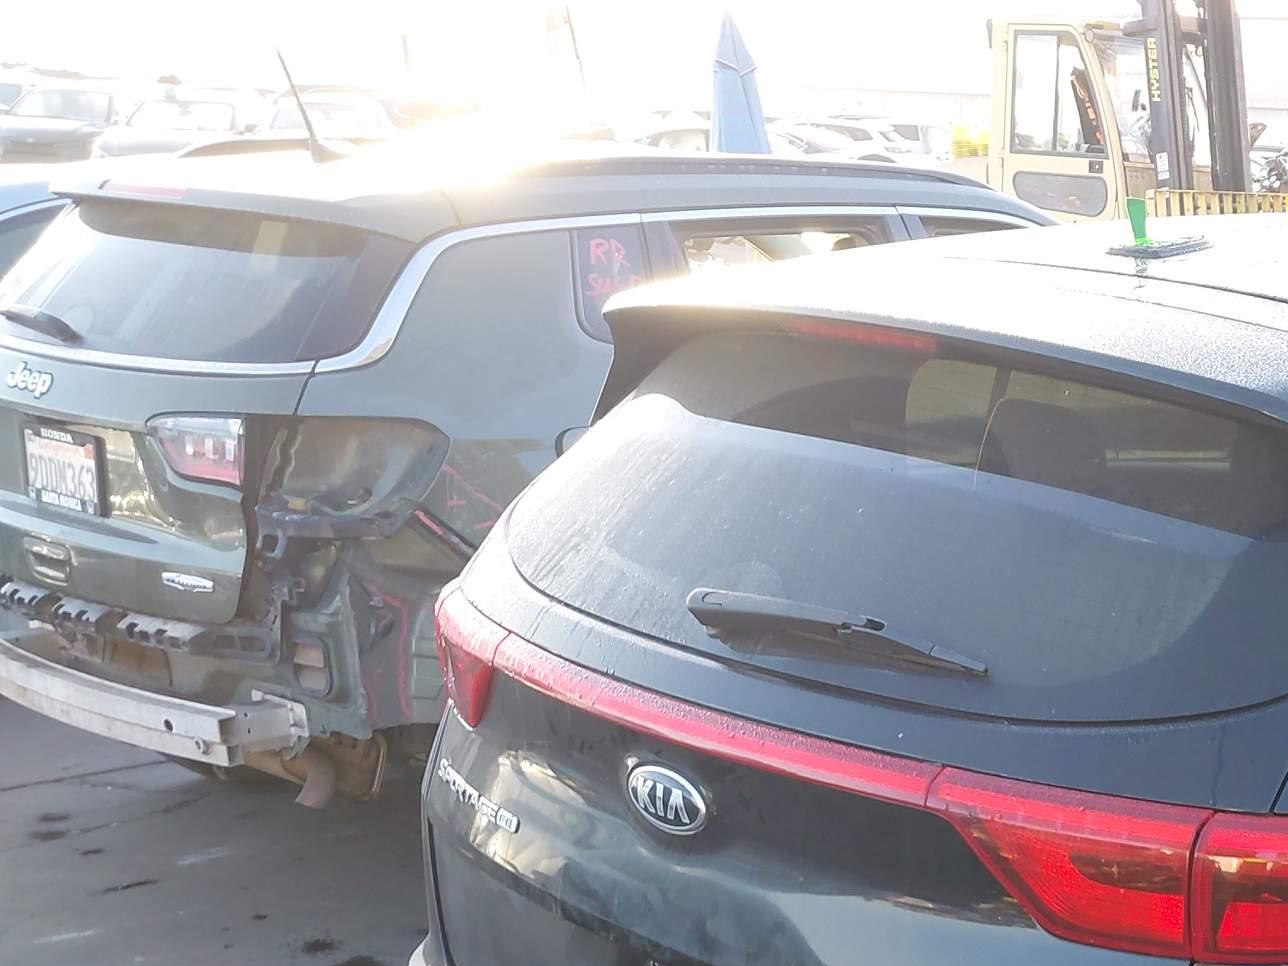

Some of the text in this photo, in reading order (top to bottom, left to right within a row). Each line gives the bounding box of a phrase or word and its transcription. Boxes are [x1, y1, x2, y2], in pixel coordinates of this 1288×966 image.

[1147, 37, 1161, 102] HYSTER
[7, 361, 54, 399] Jeep
[40, 427, 74, 444] HONDA
[438, 758, 498, 826] SPORTAGE
[637, 775, 690, 824] KIA
